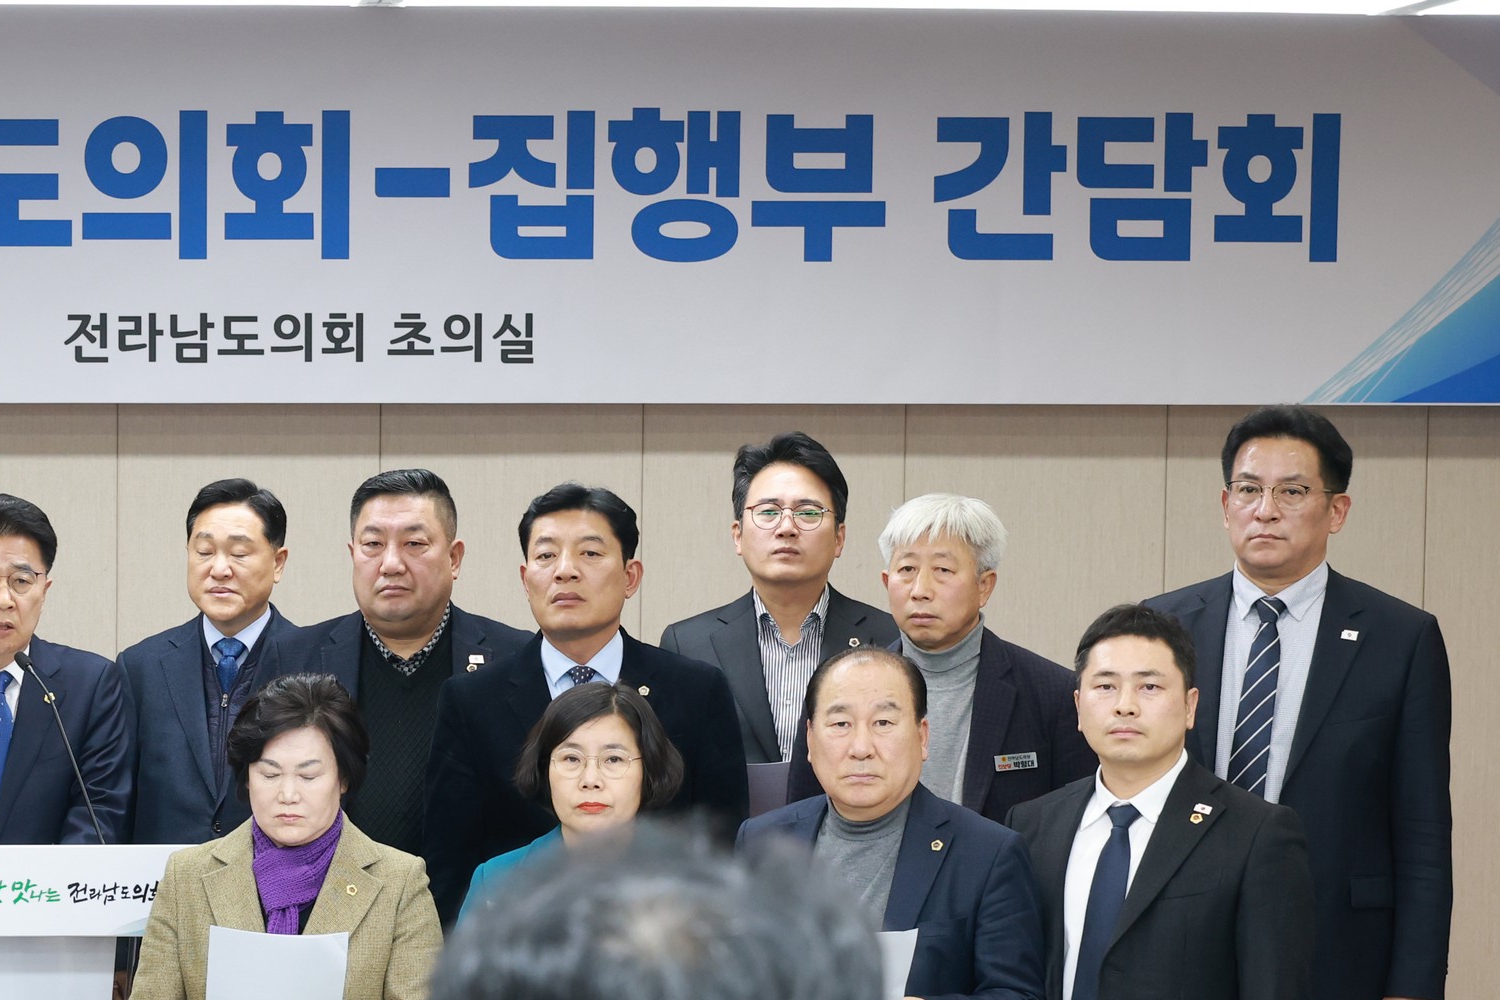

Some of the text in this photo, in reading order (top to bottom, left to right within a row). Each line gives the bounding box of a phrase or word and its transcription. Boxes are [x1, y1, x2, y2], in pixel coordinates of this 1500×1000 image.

[933, 111, 1342, 263] 간담회
[63, 312, 535, 364] 전라남도의회 초의실
